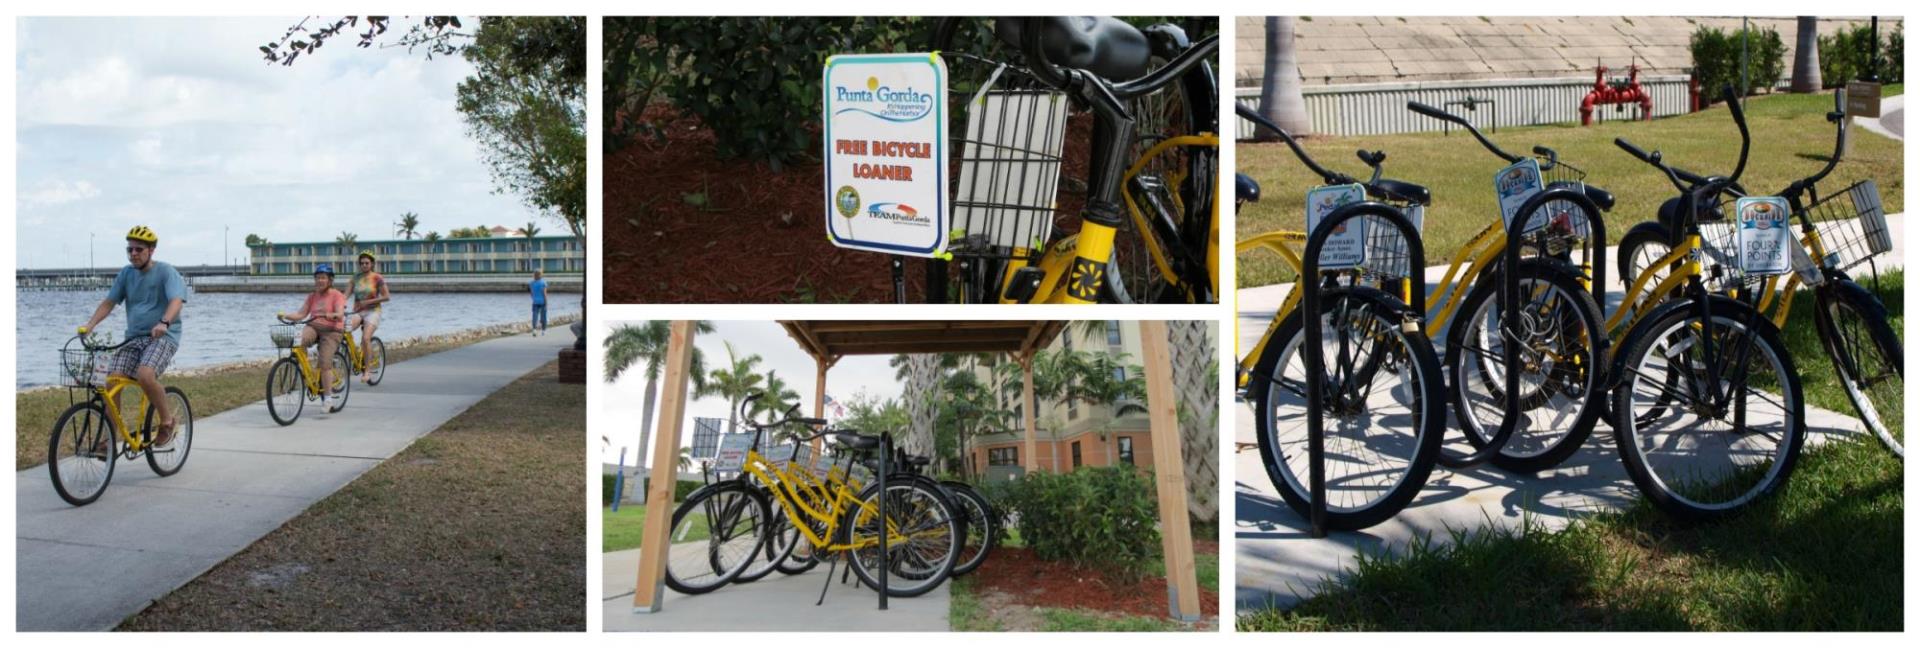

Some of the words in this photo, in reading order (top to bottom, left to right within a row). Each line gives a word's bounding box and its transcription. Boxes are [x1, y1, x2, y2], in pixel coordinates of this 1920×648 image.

[836, 86, 873, 102] Punta
[876, 86, 920, 102] Gorda
[836, 139, 867, 155] FREE
[872, 141, 931, 158] BICYCLE
[853, 163, 912, 181] LOANER
[1747, 251, 1782, 261] POINTS
